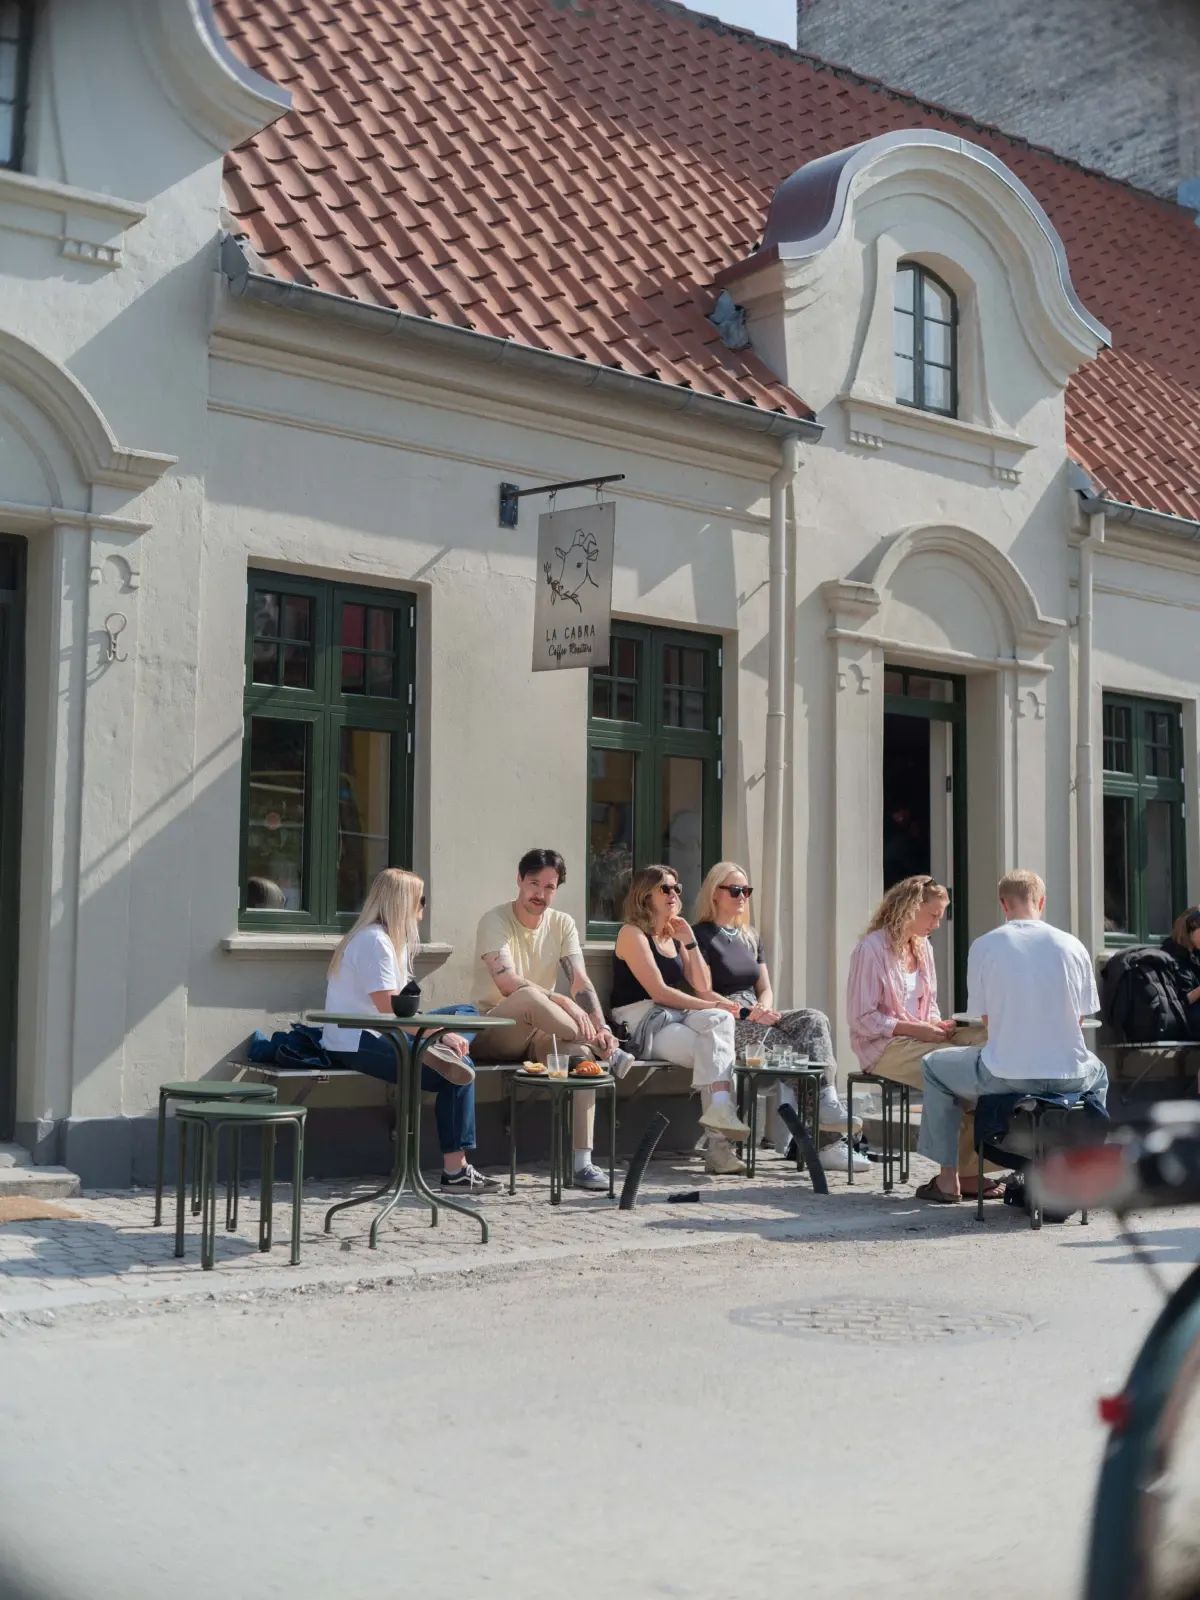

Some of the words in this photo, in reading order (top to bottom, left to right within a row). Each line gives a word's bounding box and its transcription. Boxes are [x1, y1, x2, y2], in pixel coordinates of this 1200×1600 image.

[546, 629, 557, 641] LA
[564, 624, 596, 639] CABRA
[548, 644, 567, 660] Coffee
